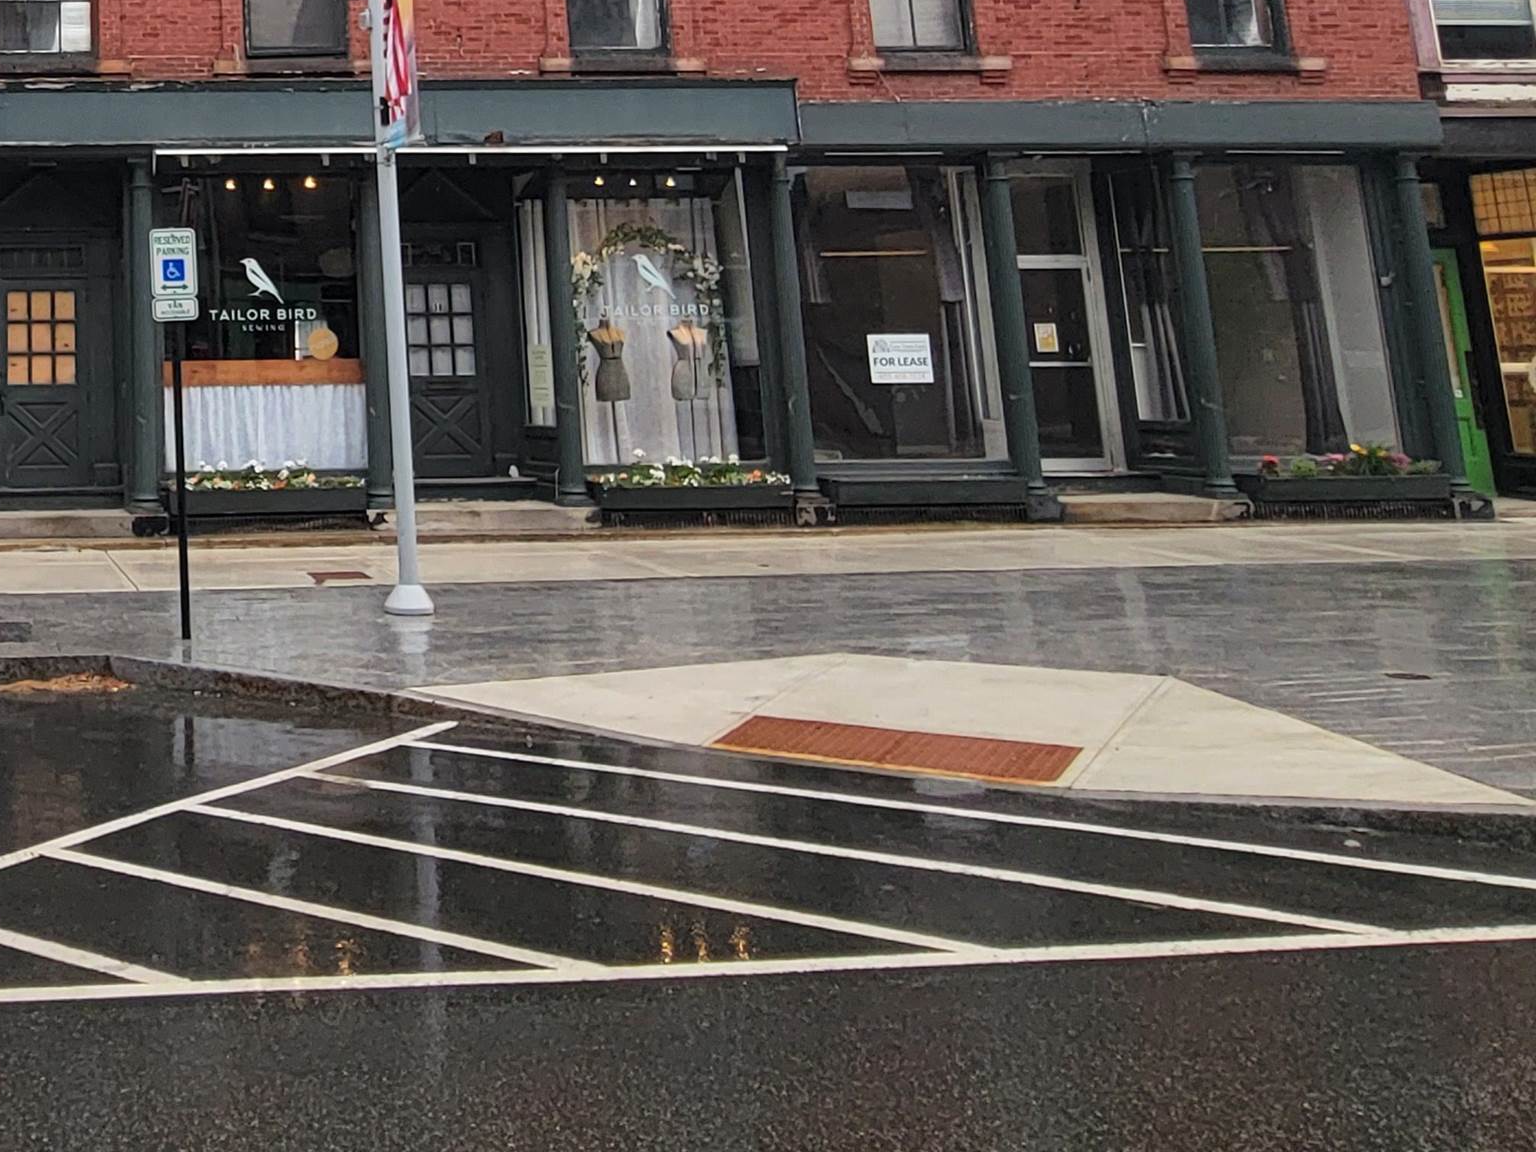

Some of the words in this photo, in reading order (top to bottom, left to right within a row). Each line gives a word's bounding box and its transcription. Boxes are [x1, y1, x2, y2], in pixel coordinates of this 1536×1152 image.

[153, 234, 191, 245] RESERVED
[156, 247, 190, 256] PARKING
[208, 308, 270, 321] TAILOR
[276, 308, 317, 320] BIRD
[669, 304, 710, 316] BIRD
[242, 324, 285, 332] SEWING
[874, 356, 895, 367] FOR
[897, 356, 929, 367] LEASE
